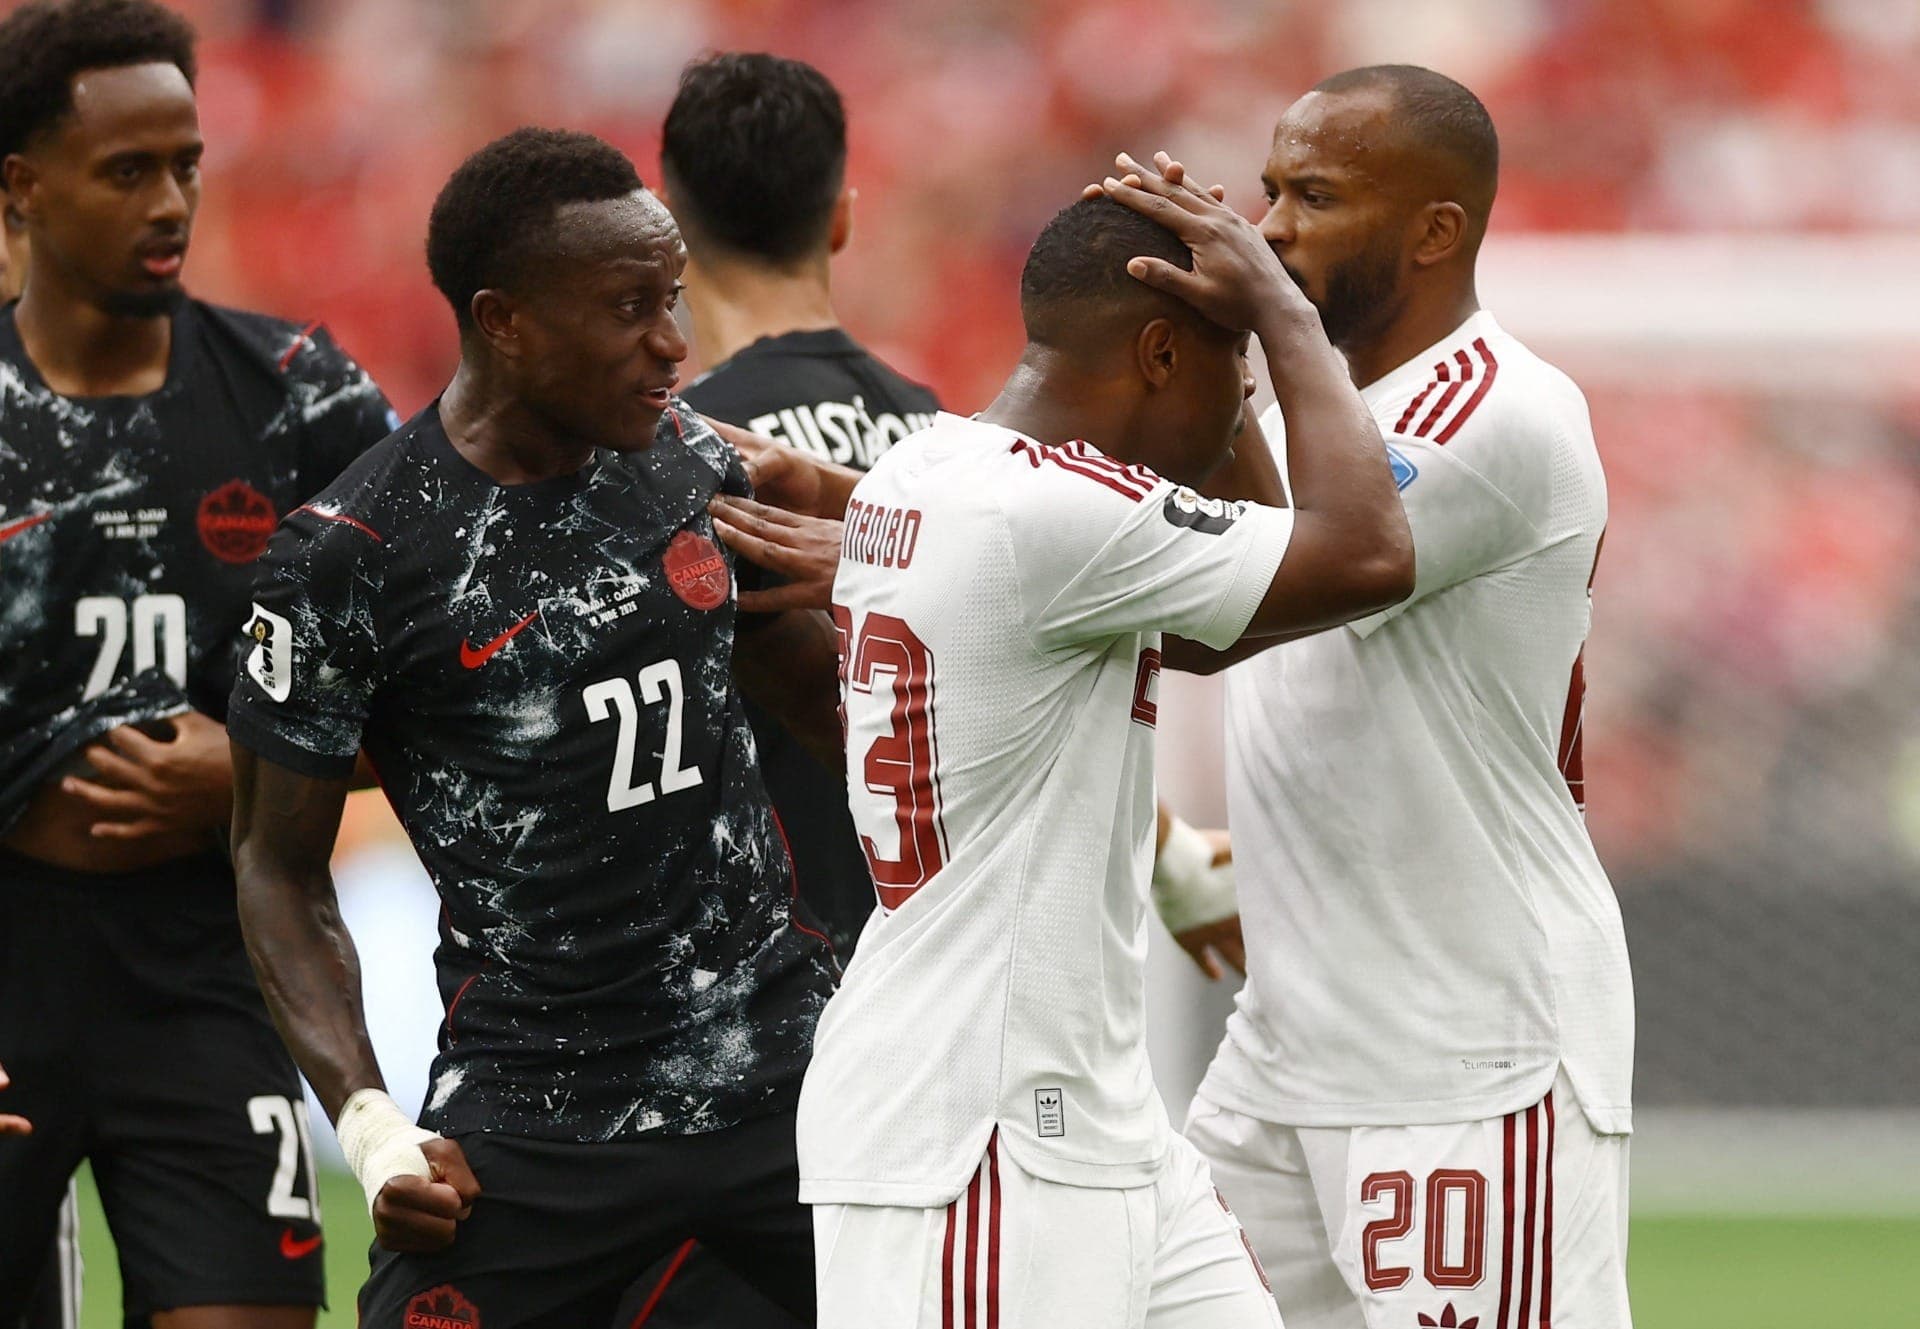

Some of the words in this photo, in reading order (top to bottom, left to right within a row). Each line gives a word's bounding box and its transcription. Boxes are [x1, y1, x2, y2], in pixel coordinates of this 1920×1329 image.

[748, 395, 939, 468] EUSTÁ
[613, 583, 642, 601] QATAR
[672, 559, 722, 584] CANADA
[75, 593, 188, 702] 20
[582, 658, 704, 813] 22
[832, 604, 950, 916] 3
[1361, 1168, 1490, 1294] 20
